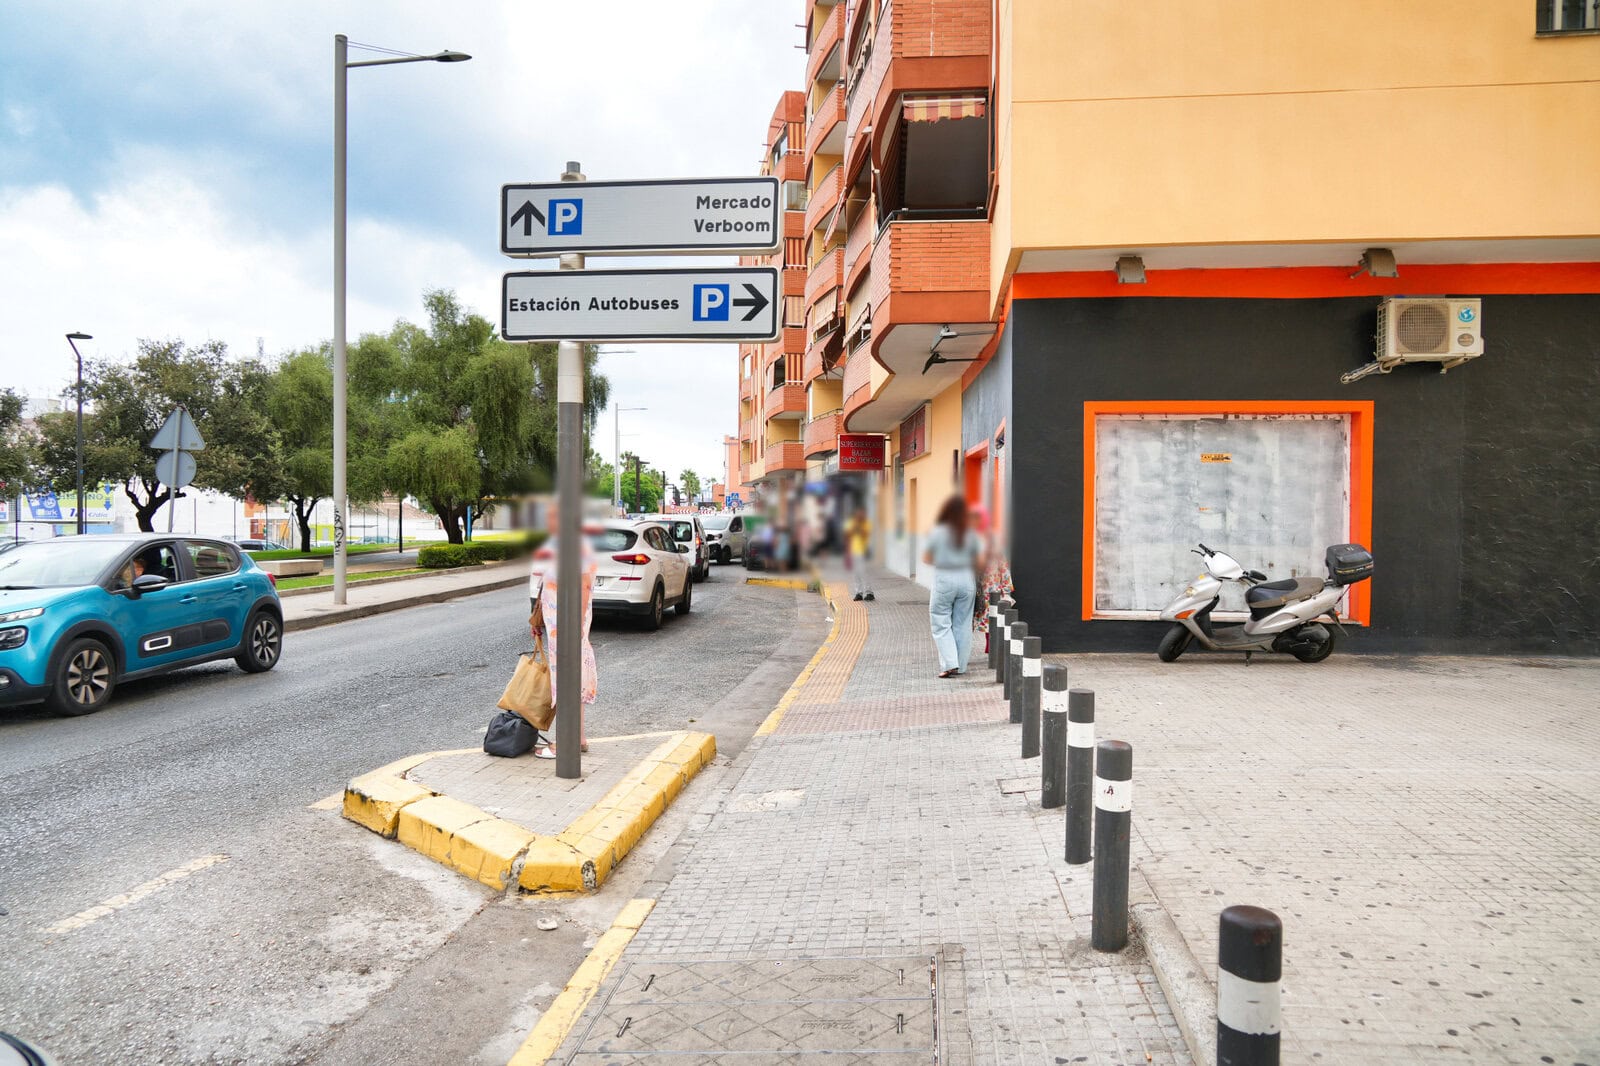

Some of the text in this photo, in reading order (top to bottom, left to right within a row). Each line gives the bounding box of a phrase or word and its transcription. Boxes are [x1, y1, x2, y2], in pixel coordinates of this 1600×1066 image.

[696, 195, 772, 210] Mercado
[555, 202, 578, 233] P
[694, 218, 771, 233] Verboom
[509, 296, 680, 312] Estación Autobuses
[701, 287, 724, 319] P
